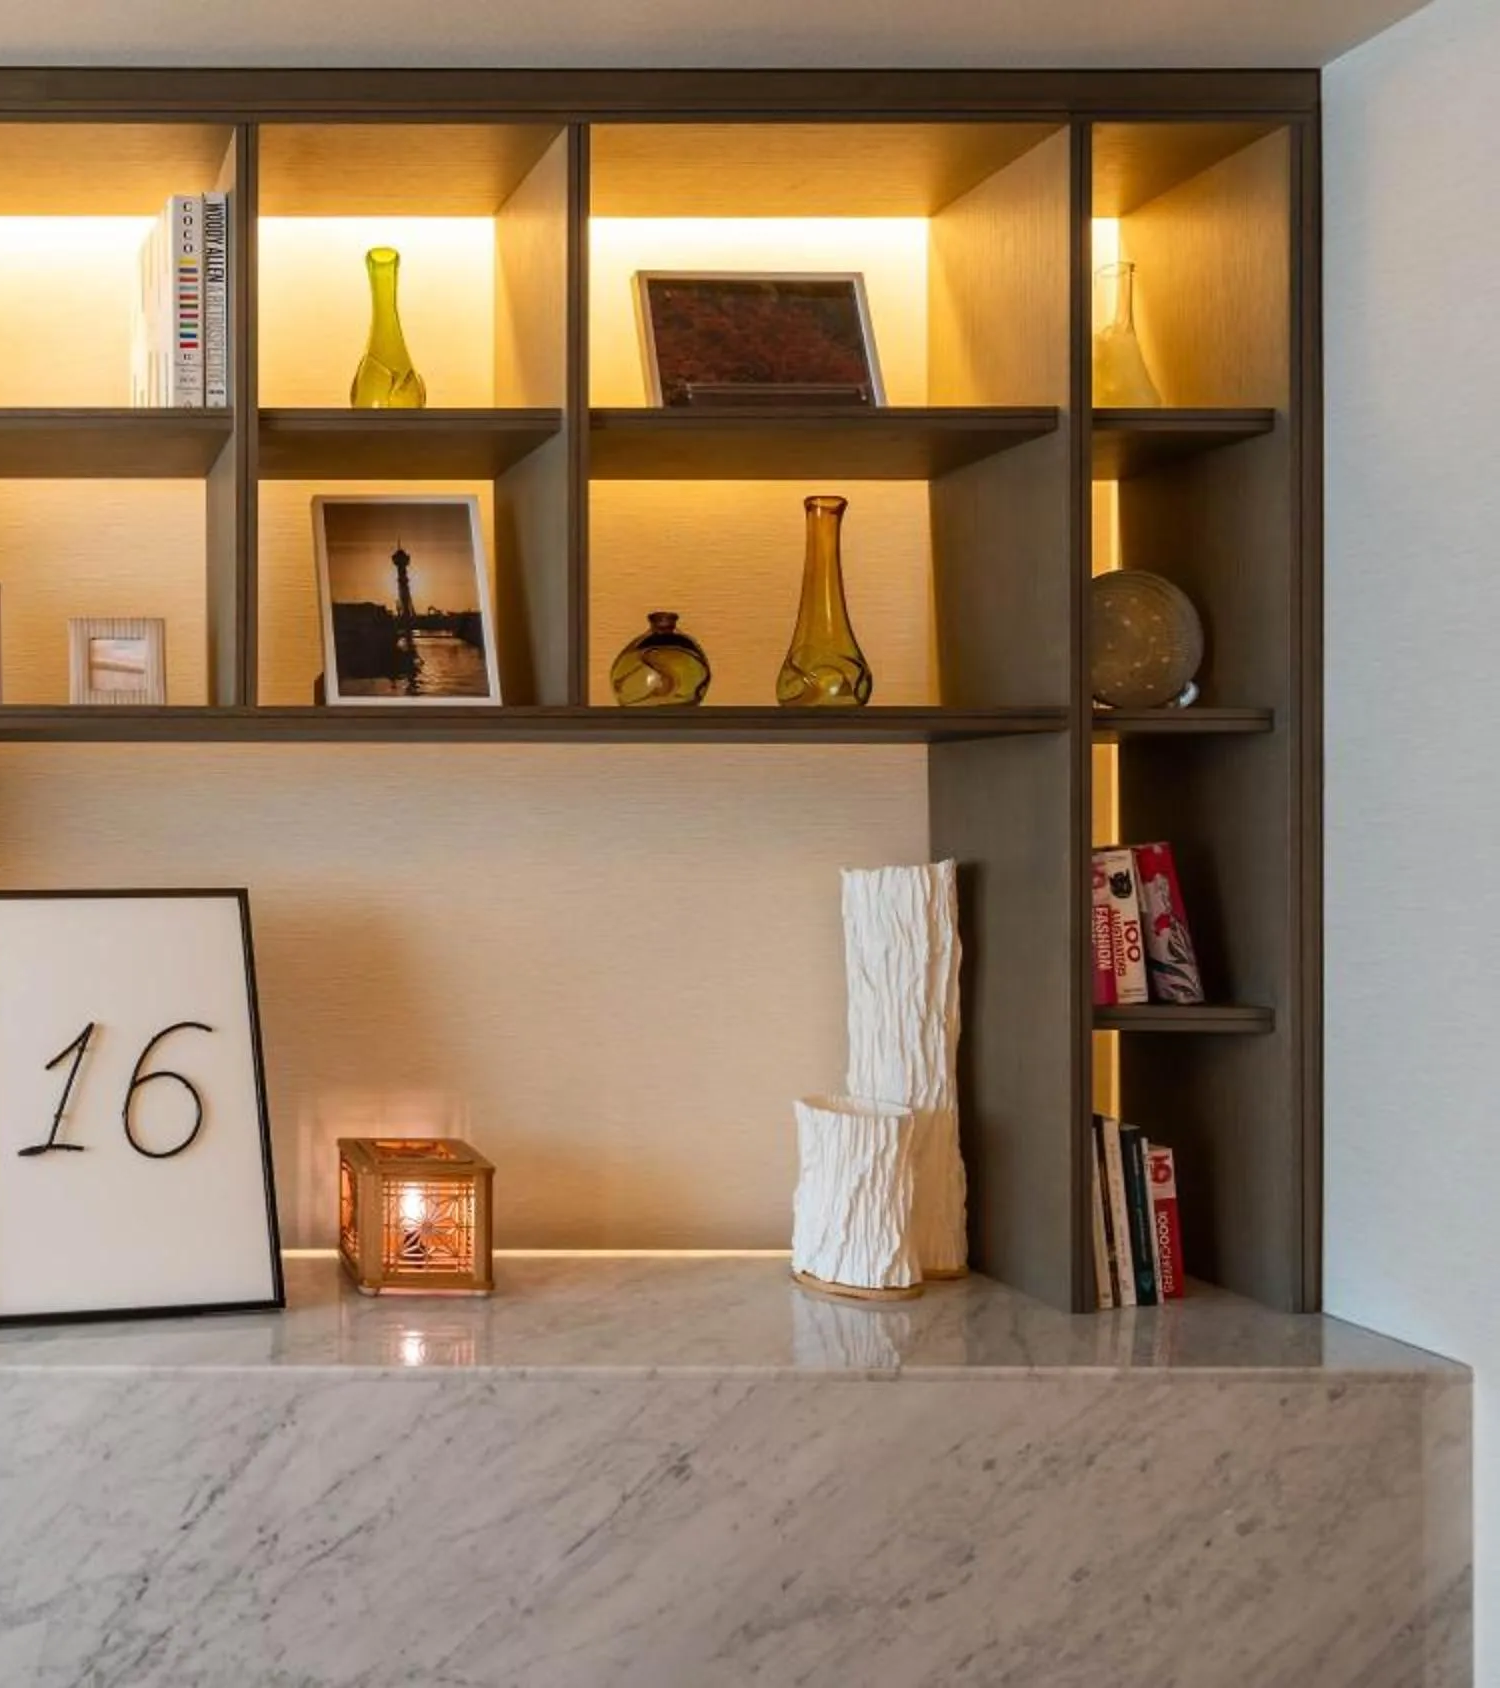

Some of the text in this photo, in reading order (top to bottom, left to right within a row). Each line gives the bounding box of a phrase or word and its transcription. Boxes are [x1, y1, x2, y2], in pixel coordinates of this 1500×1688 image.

[183, 201, 193, 253] COCO
[205, 203, 224, 244] WOODY
[206, 247, 224, 283] ALLEN
[1095, 906, 1113, 970] FASHION
[1124, 919, 1141, 963] 100
[17, 1021, 214, 1159] 16
